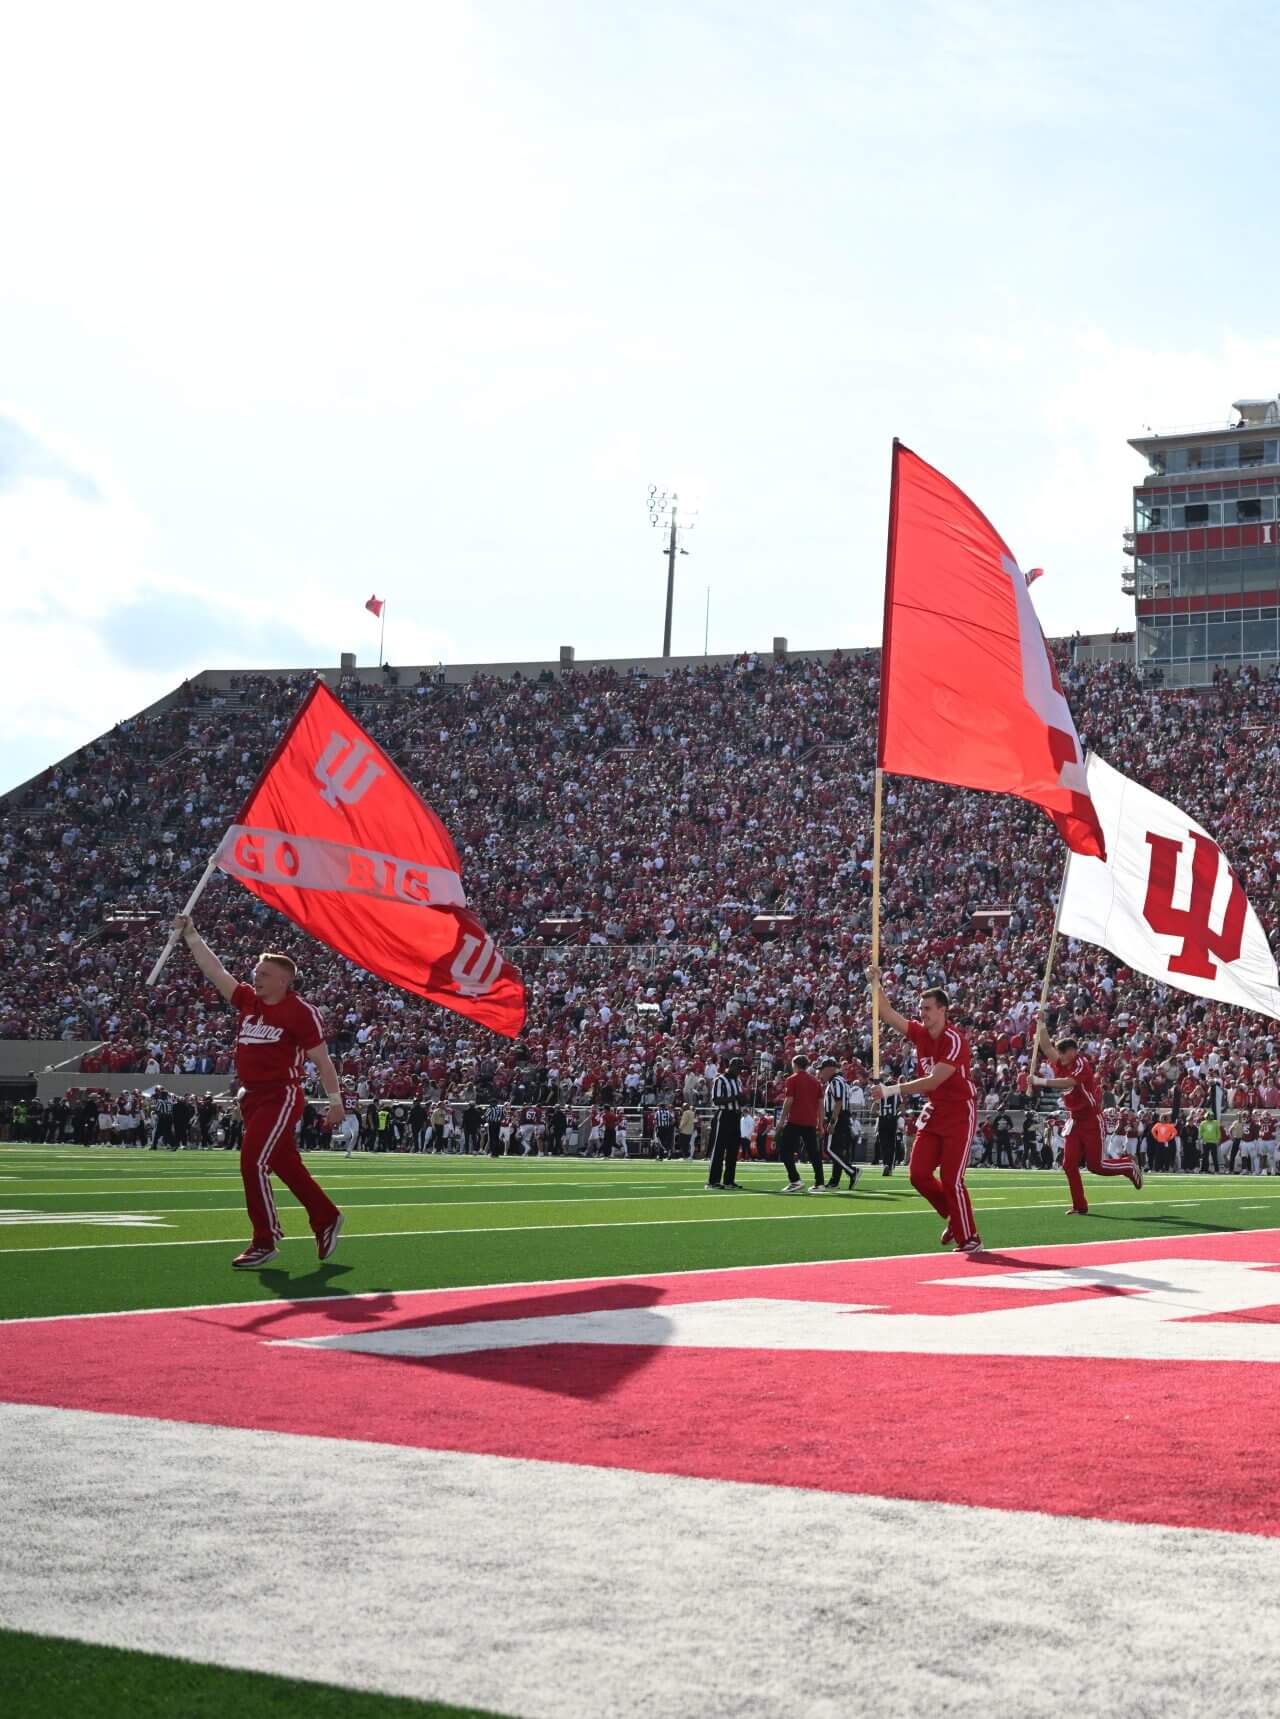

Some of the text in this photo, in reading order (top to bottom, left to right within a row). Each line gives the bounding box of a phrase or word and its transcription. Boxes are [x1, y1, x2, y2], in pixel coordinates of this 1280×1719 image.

[315, 731, 385, 812] IU
[235, 833, 433, 903] GO BIG
[1142, 829, 1249, 981] IU
[450, 933, 504, 998] IU
[239, 1015, 285, 1041] Indiana
